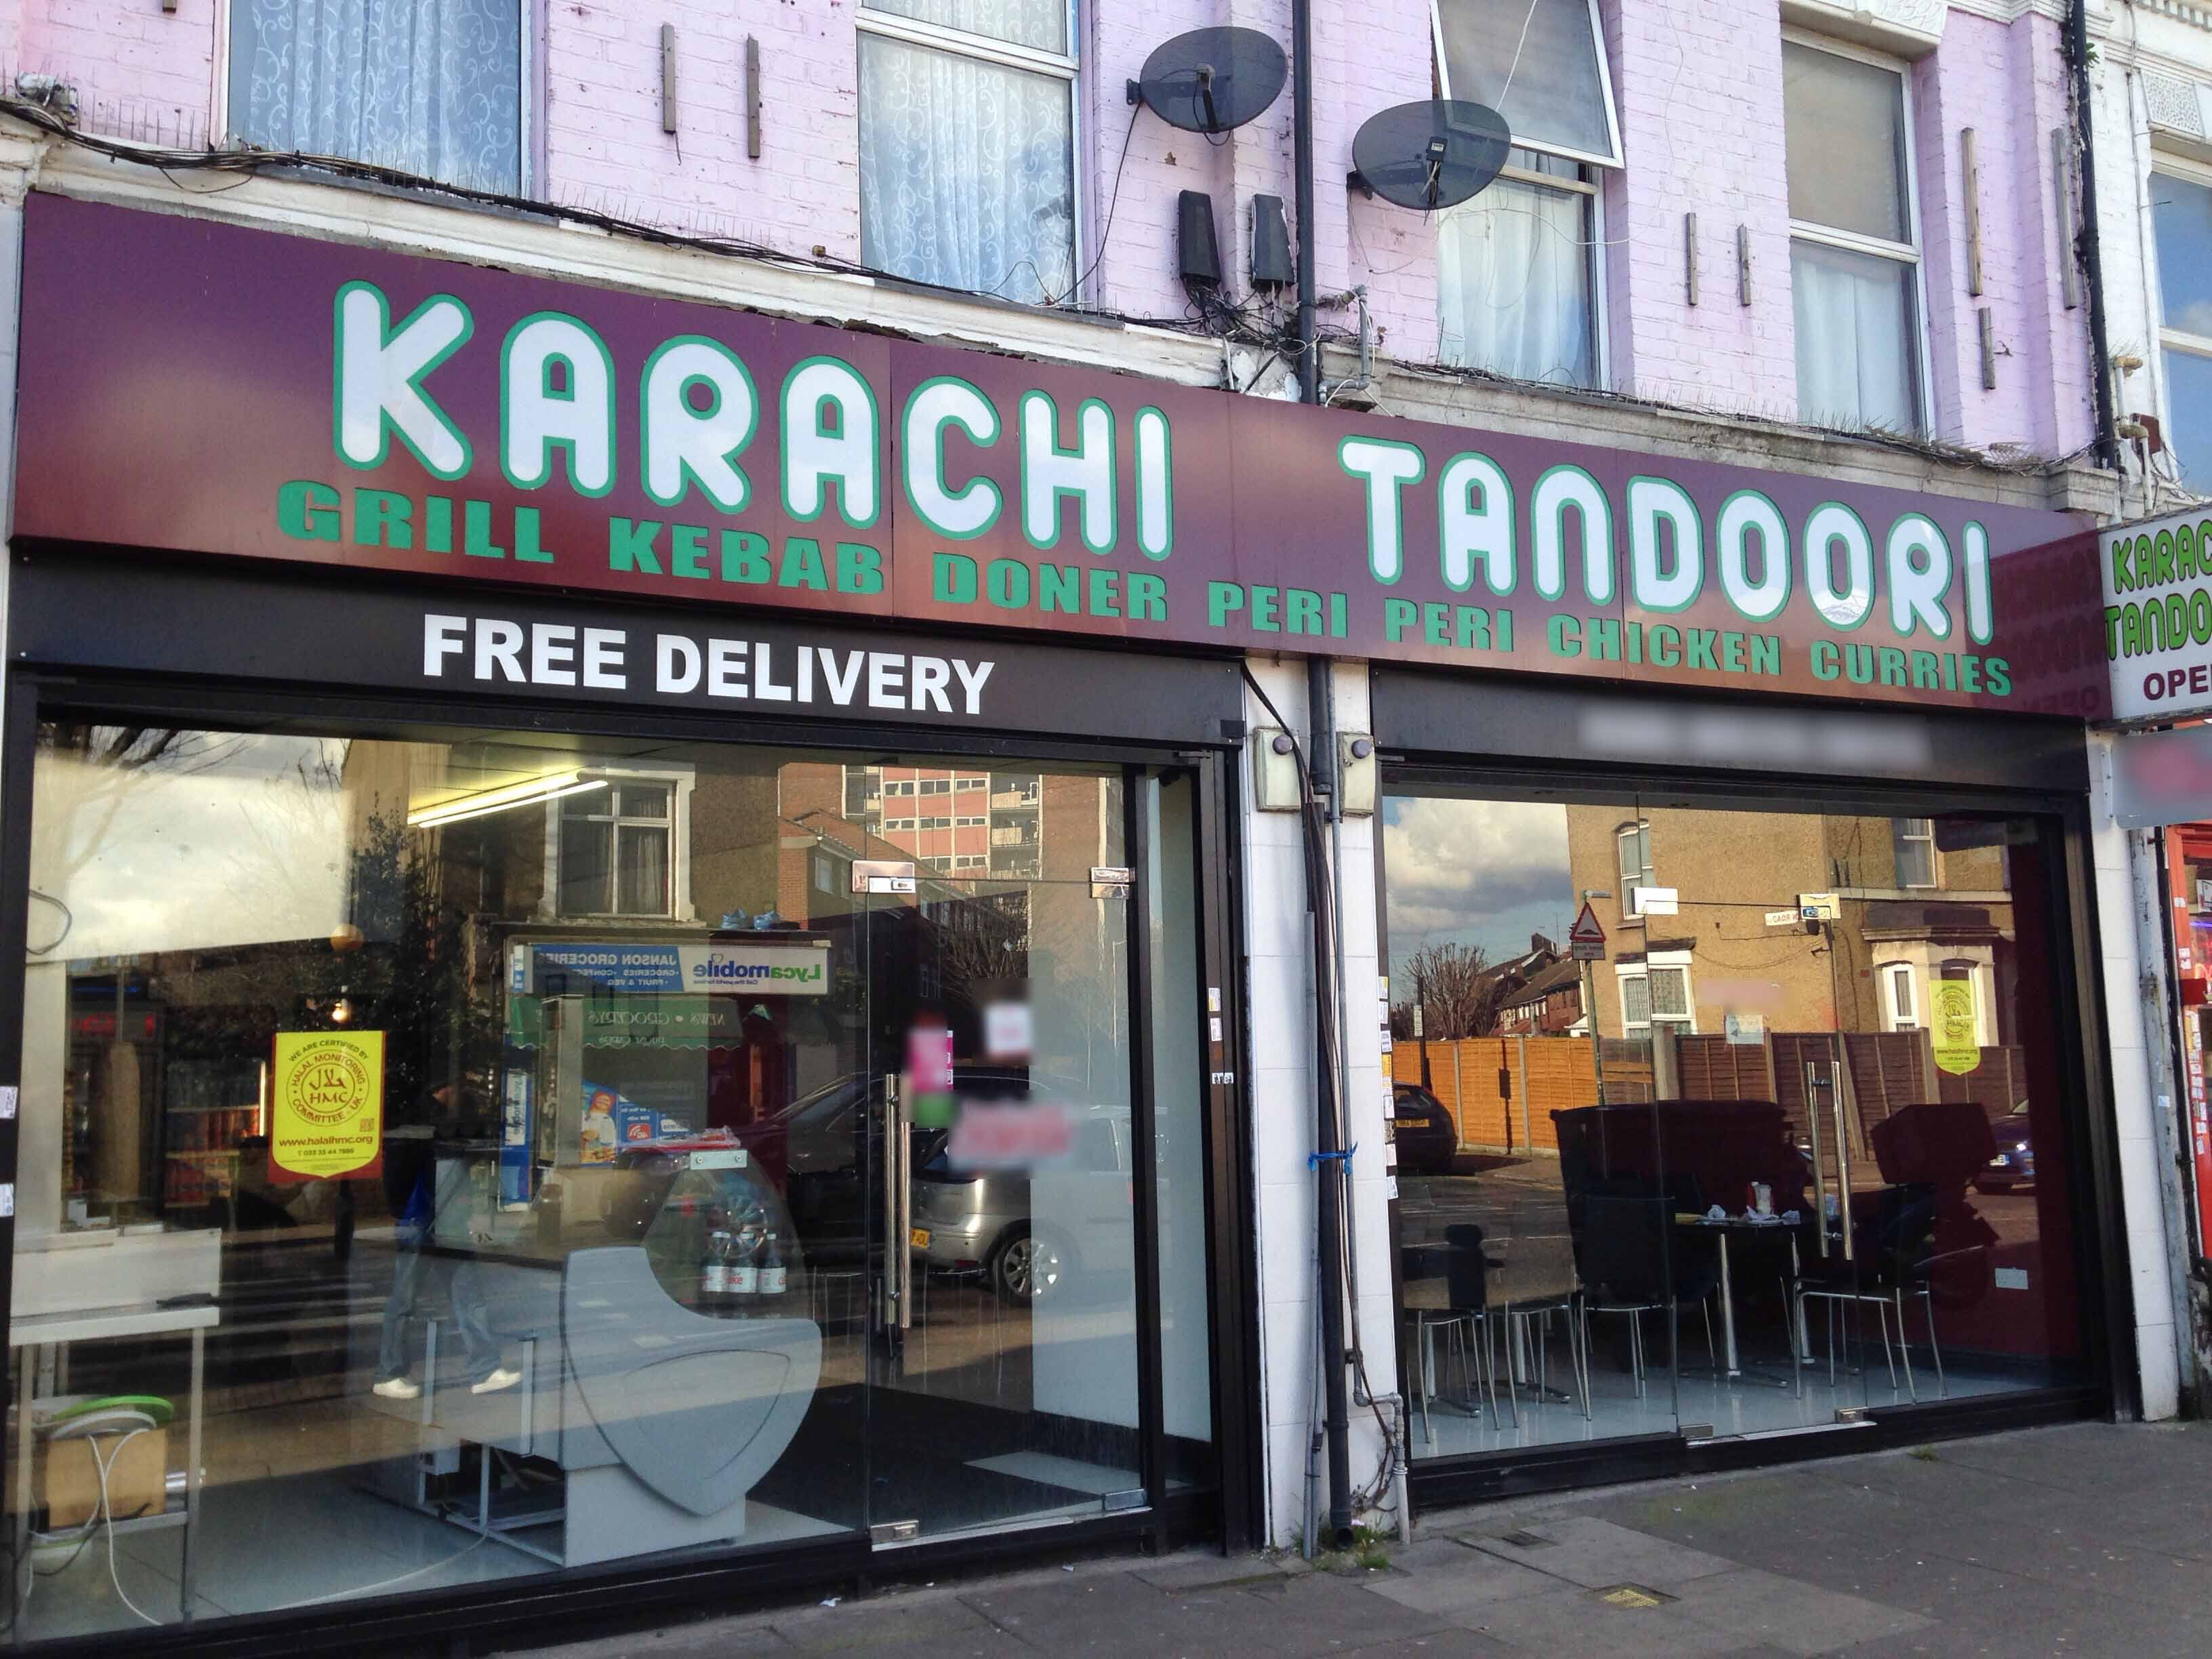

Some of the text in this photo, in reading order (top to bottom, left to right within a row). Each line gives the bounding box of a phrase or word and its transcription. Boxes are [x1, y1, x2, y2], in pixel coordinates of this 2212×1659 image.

[333, 280, 1994, 644] KARACHI TANDOORI
[2112, 519, 2212, 594] KARAC
[276, 480, 554, 563] GRILL
[609, 516, 884, 595] KEBAB
[933, 552, 1168, 621] DONER
[1208, 581, 1349, 638] PERI
[1385, 598, 1515, 653] PERI
[1547, 614, 1782, 676] CHICKEN
[1810, 640, 2012, 697] CURRIES
[2104, 588, 2212, 661] TANDO
[424, 614, 996, 715] FREE DELIVERY
[2144, 663, 2212, 701] OPE
[289, 1040, 369, 1062] WE ARE CERTIFIED BY
[292, 1052, 366, 1086] HALAL MONITORING
[292, 1096, 363, 1123] COMMITTEE UK
[309, 1092, 348, 1104] HMC
[279, 1135, 373, 1147] www.halalhmc.org
